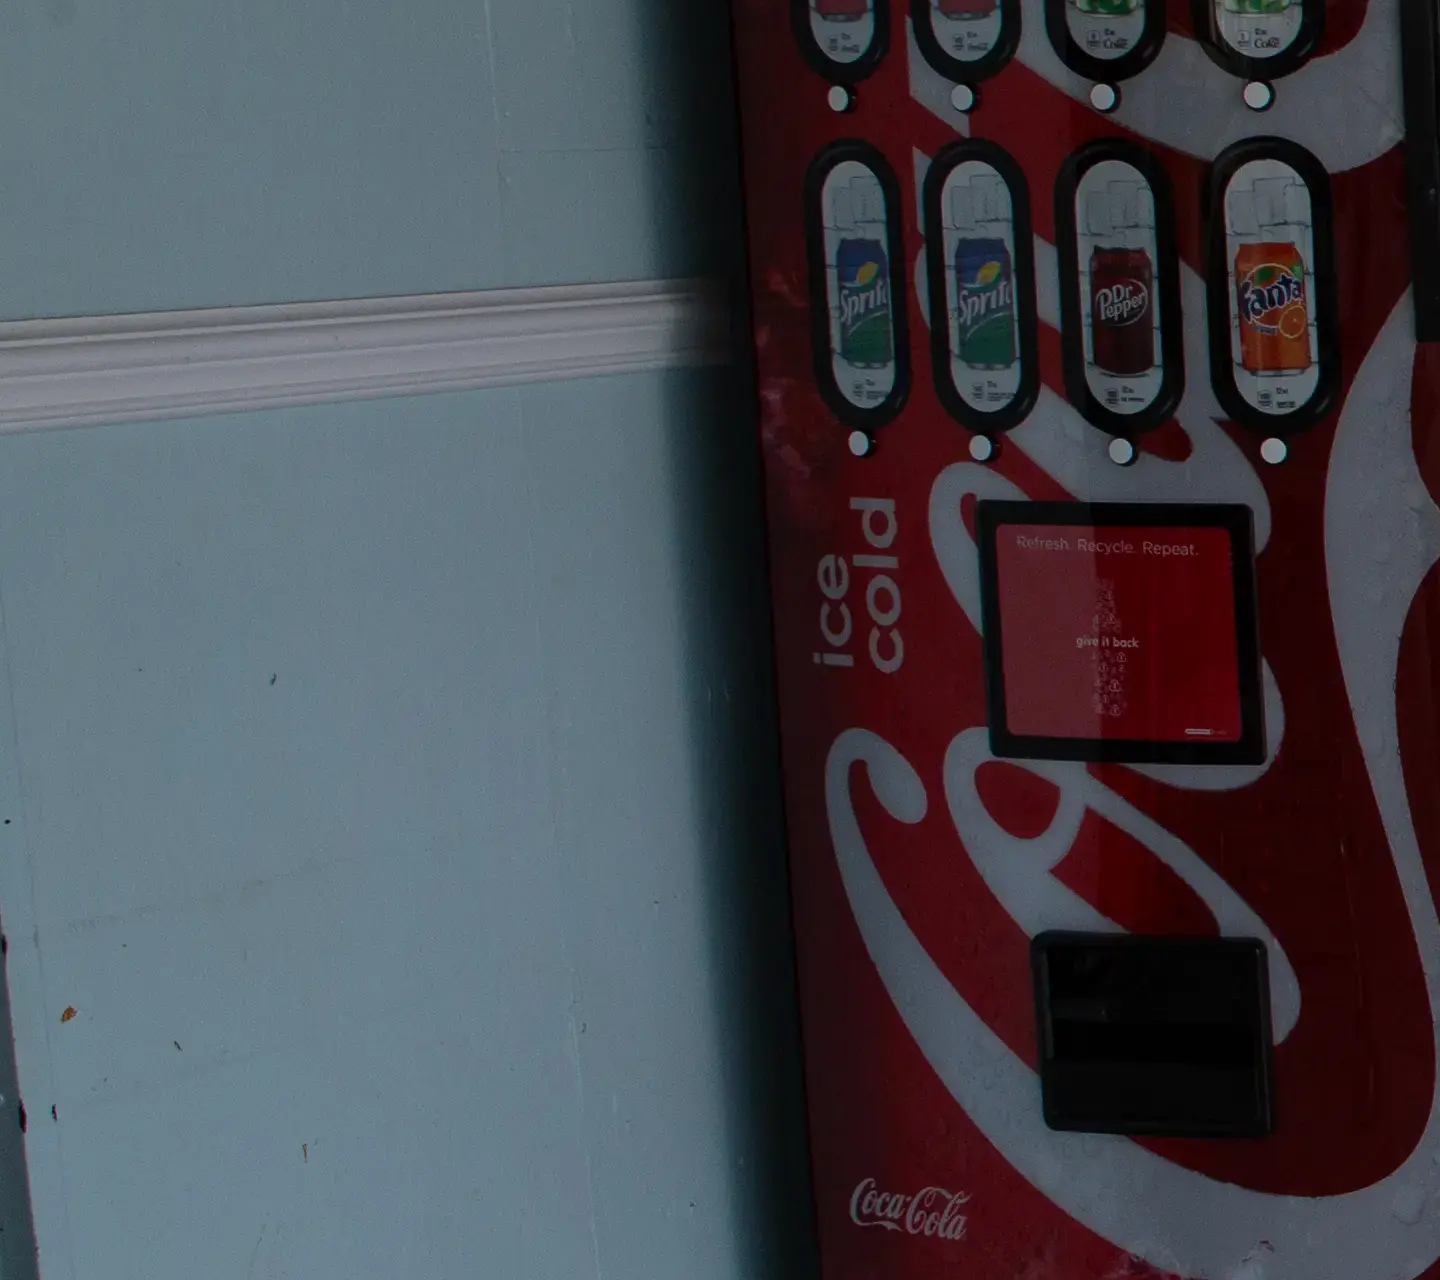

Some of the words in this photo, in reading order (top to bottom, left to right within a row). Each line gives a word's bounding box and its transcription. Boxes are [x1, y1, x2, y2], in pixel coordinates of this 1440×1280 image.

[1096, 290, 1146, 322] Pepper
[1112, 283, 1134, 299] Dr
[1241, 275, 1304, 324] Fanta
[1143, 541, 1199, 557] Repeat.
[850, 496, 904, 674] cold
[813, 554, 854, 667] ice
[1076, 637, 1099, 649] give
[1101, 636, 1110, 647] it
[1113, 636, 1140, 648] back
[849, 1177, 973, 1240] Coca-Cola
